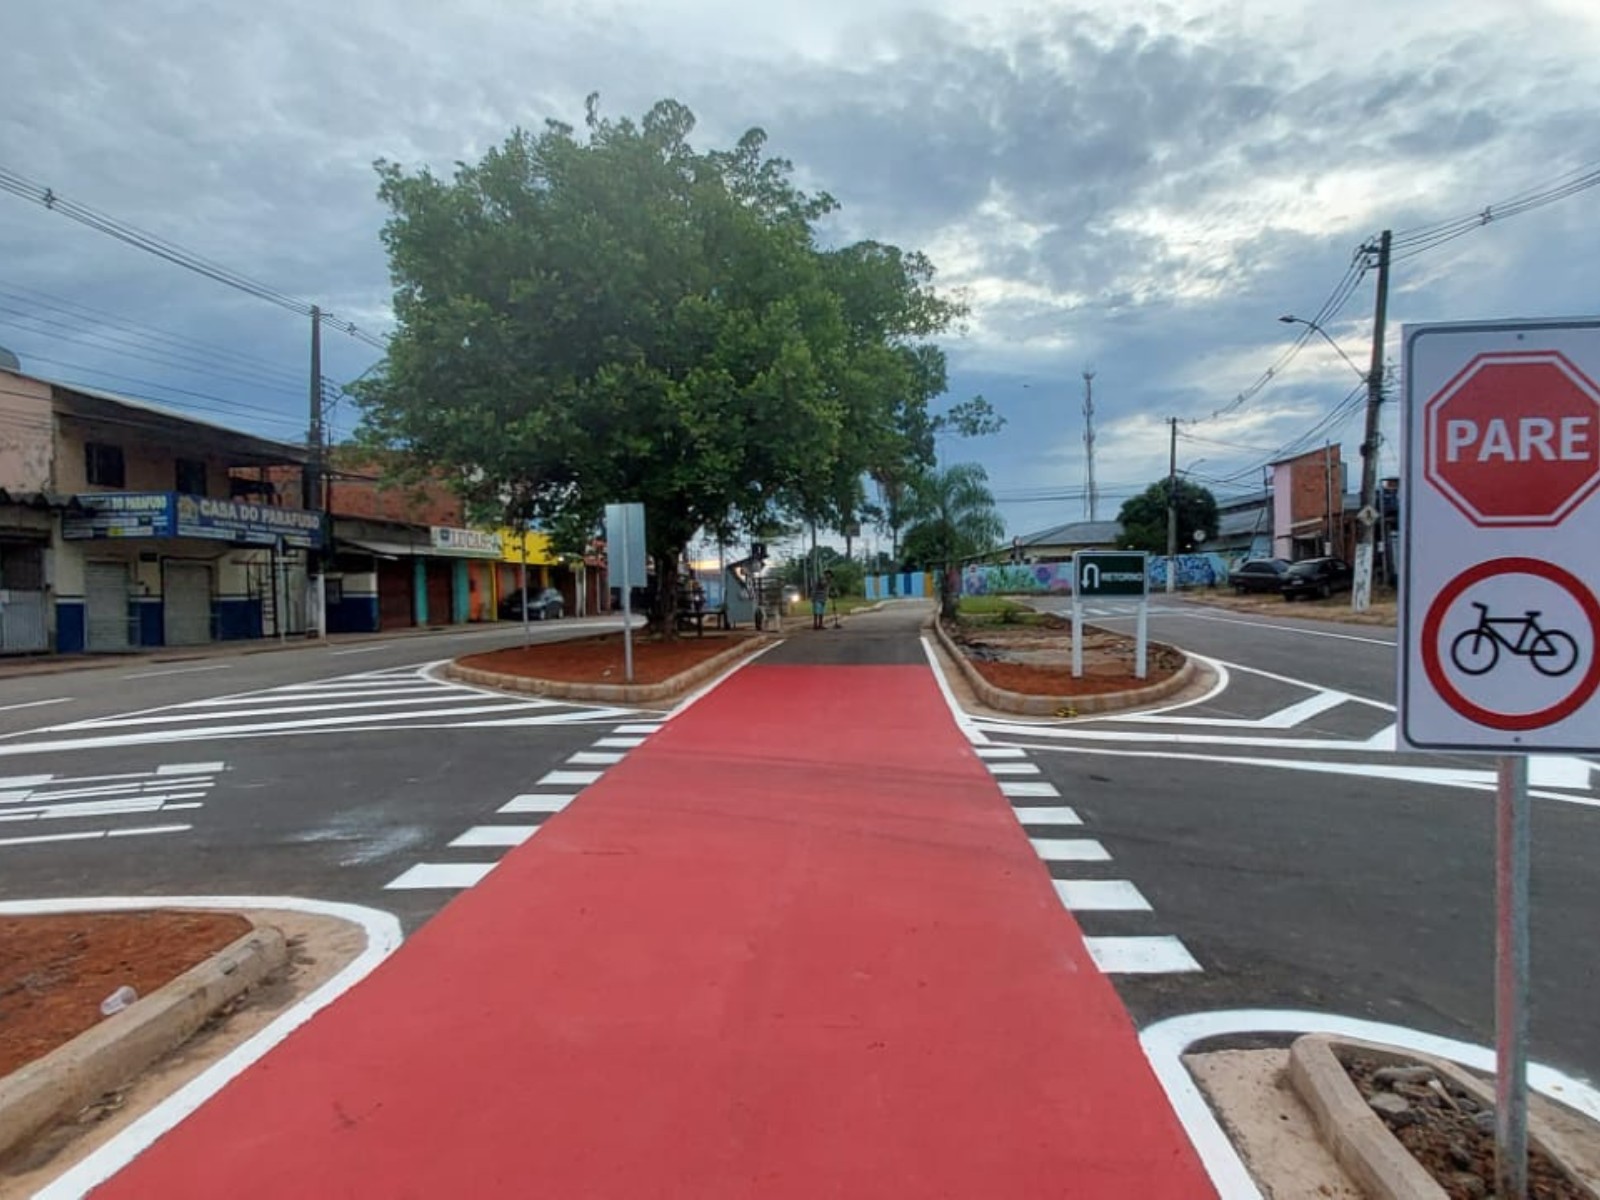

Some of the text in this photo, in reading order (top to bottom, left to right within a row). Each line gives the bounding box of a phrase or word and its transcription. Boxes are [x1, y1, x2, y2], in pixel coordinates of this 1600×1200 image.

[1446, 416, 1590, 462] PARE
[200, 499, 238, 520] CASA
[240, 505, 259, 521] DO
